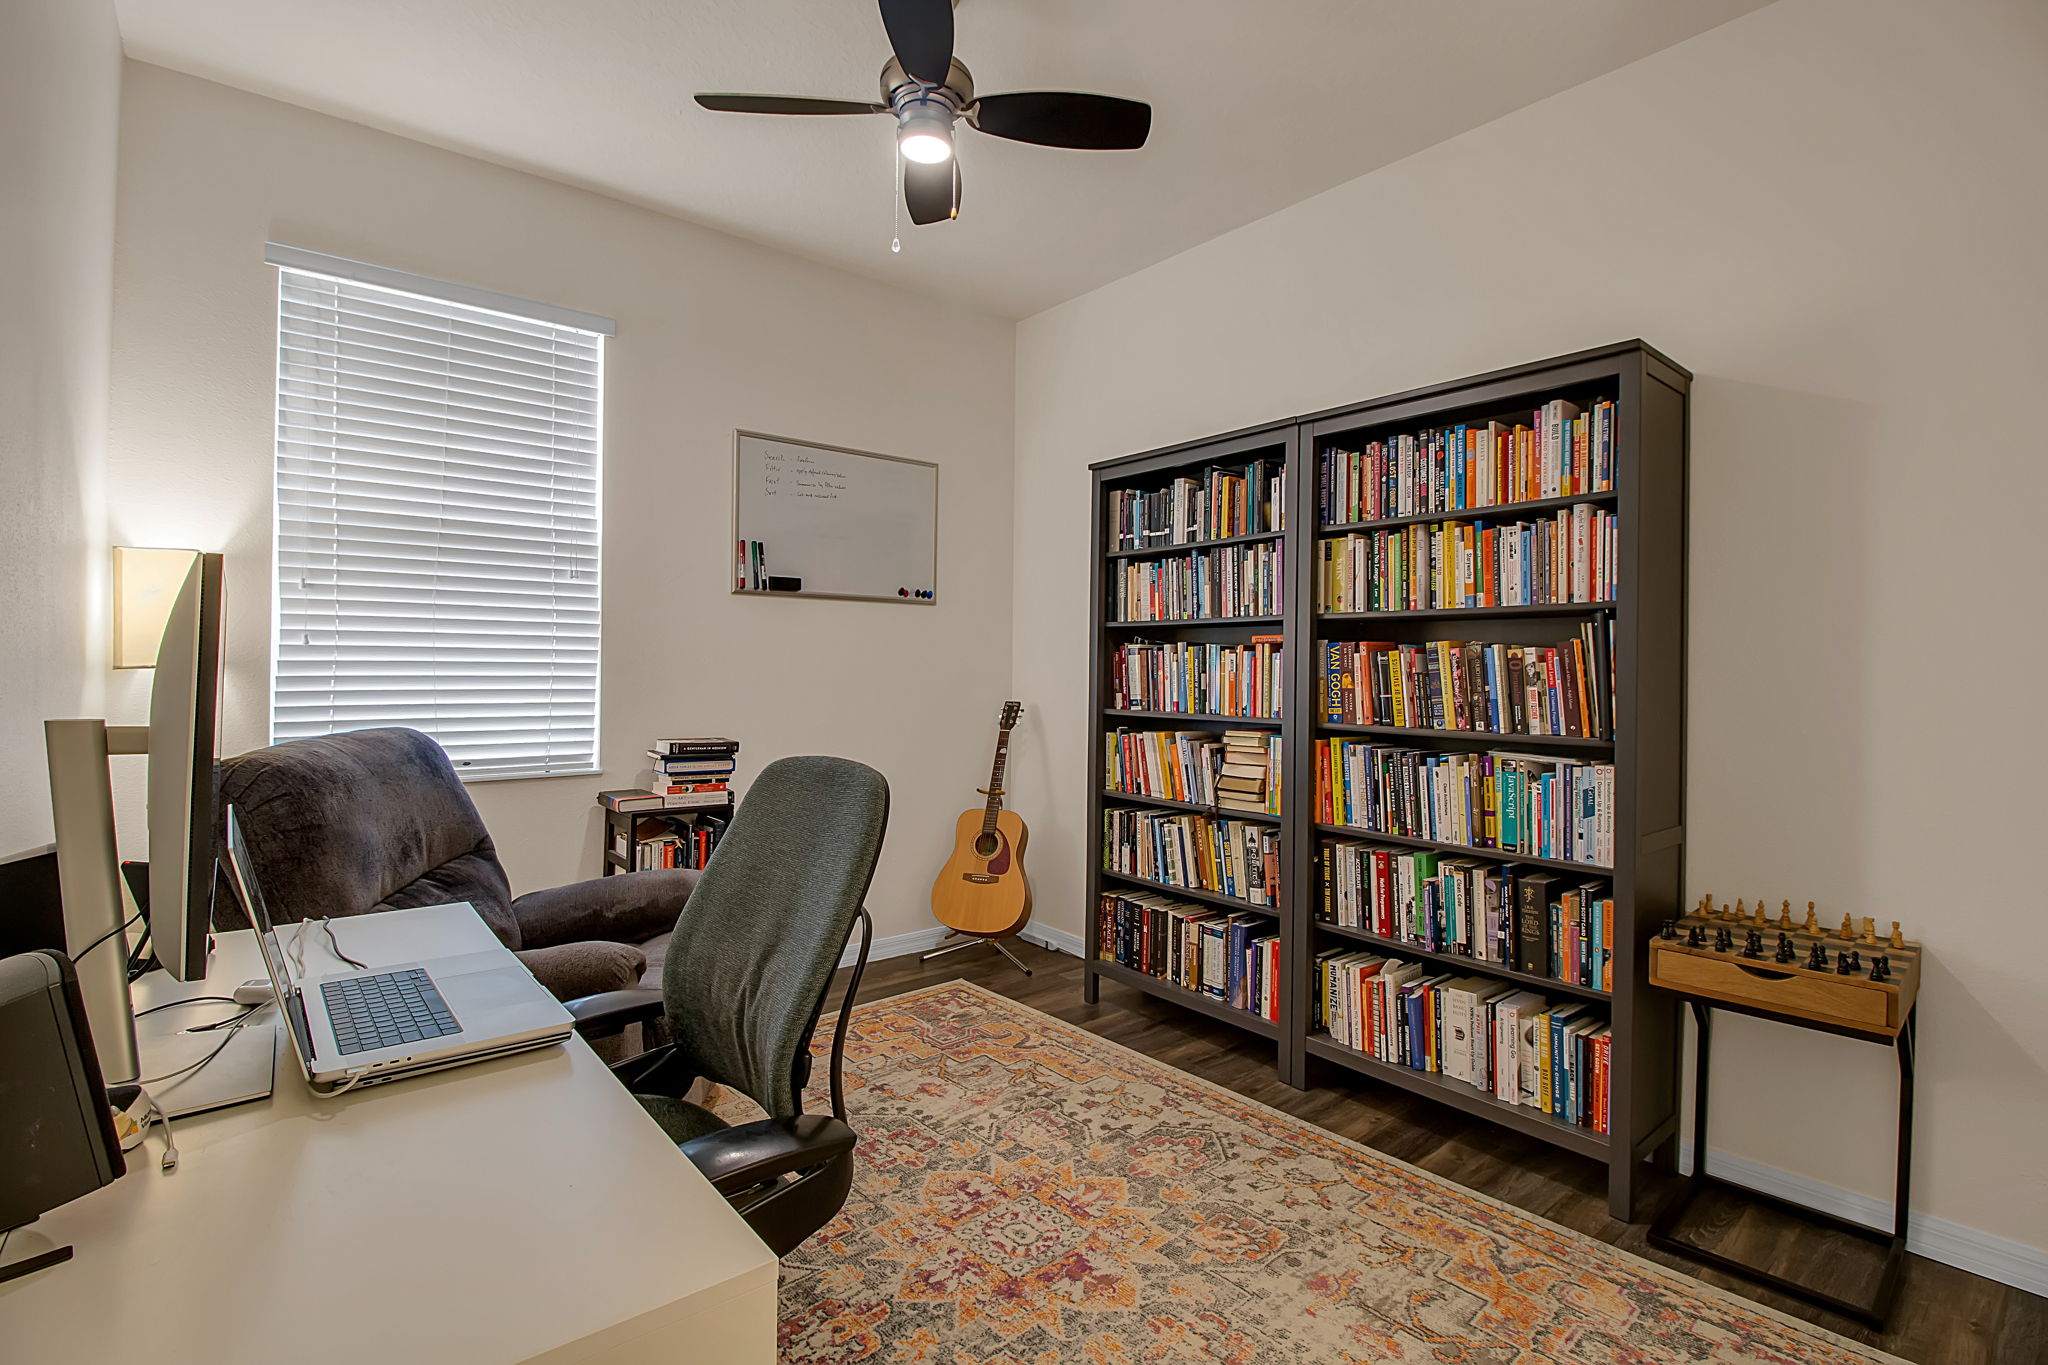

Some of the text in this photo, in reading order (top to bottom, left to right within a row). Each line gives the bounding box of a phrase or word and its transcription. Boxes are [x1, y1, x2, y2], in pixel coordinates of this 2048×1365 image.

[1330, 646, 1341, 706] VAN GOGH
[1506, 774, 1516, 819] JavaScript
[1510, 1050, 1516, 1059] Go
